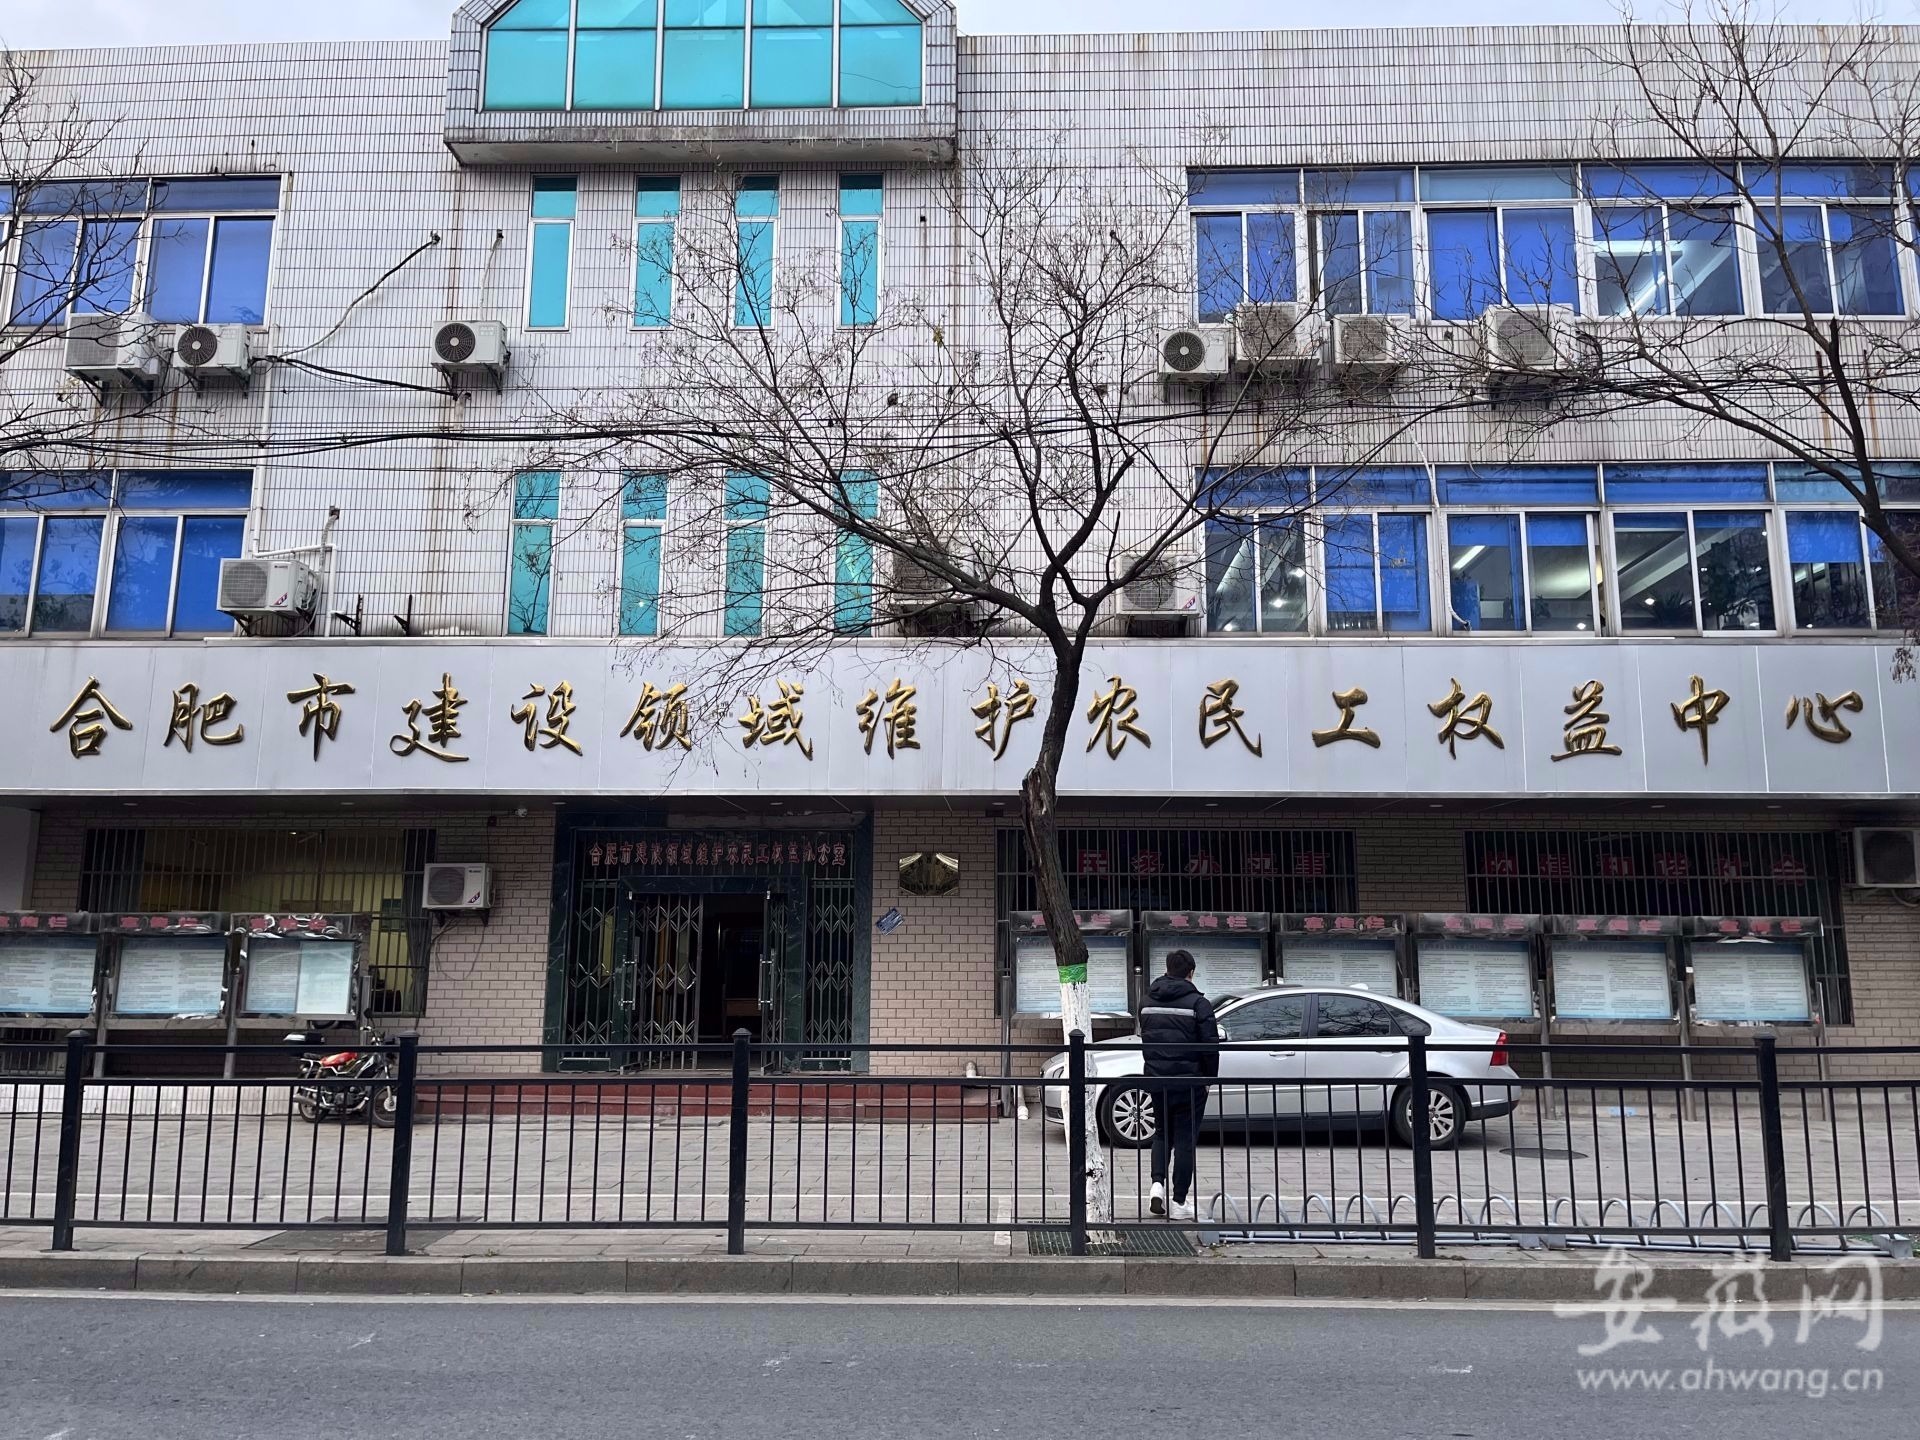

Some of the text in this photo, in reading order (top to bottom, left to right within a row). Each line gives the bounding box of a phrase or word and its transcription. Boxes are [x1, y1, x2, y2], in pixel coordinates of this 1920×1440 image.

[50, 672, 1863, 766] 合肥市建设领域维护农民工权益中心
